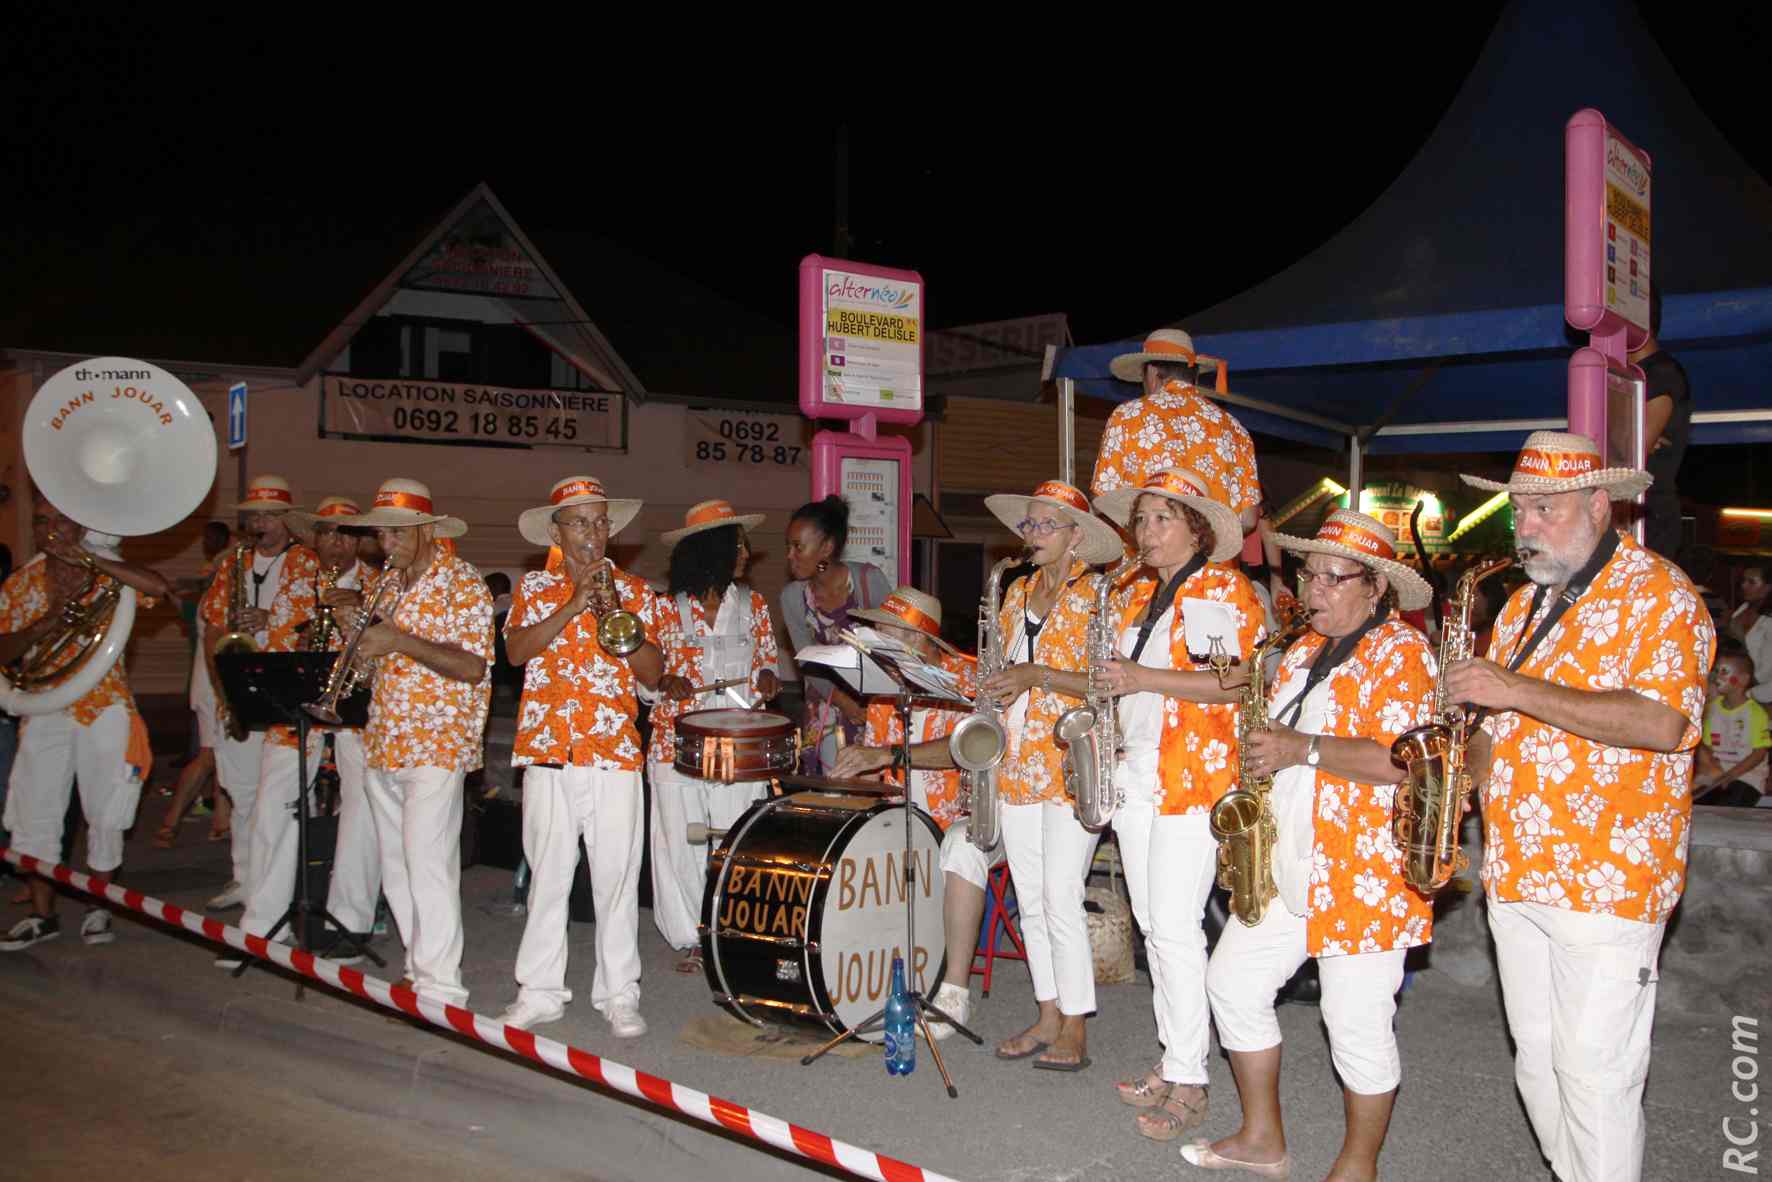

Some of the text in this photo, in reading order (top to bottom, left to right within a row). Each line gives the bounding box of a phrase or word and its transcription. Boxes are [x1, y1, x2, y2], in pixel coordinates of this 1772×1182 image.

[828, 320, 915, 342] HUBERT DELISLE
[840, 311, 904, 329] BOULEVARD
[338, 381, 455, 402] LOCATION
[51, 386, 173, 430] BANN JOUAR
[394, 406, 577, 440] 0692 18 85 45
[719, 419, 779, 442] 0692
[696, 441, 801, 465] 85 78 87
[1520, 455, 1592, 472] BANN JOUAR
[1347, 530, 1378, 552] JOUAR
[728, 865, 812, 904] BANN
[838, 848, 932, 911] BANN
[720, 897, 807, 937] JOUAR
[828, 945, 929, 1008] JOUAR
